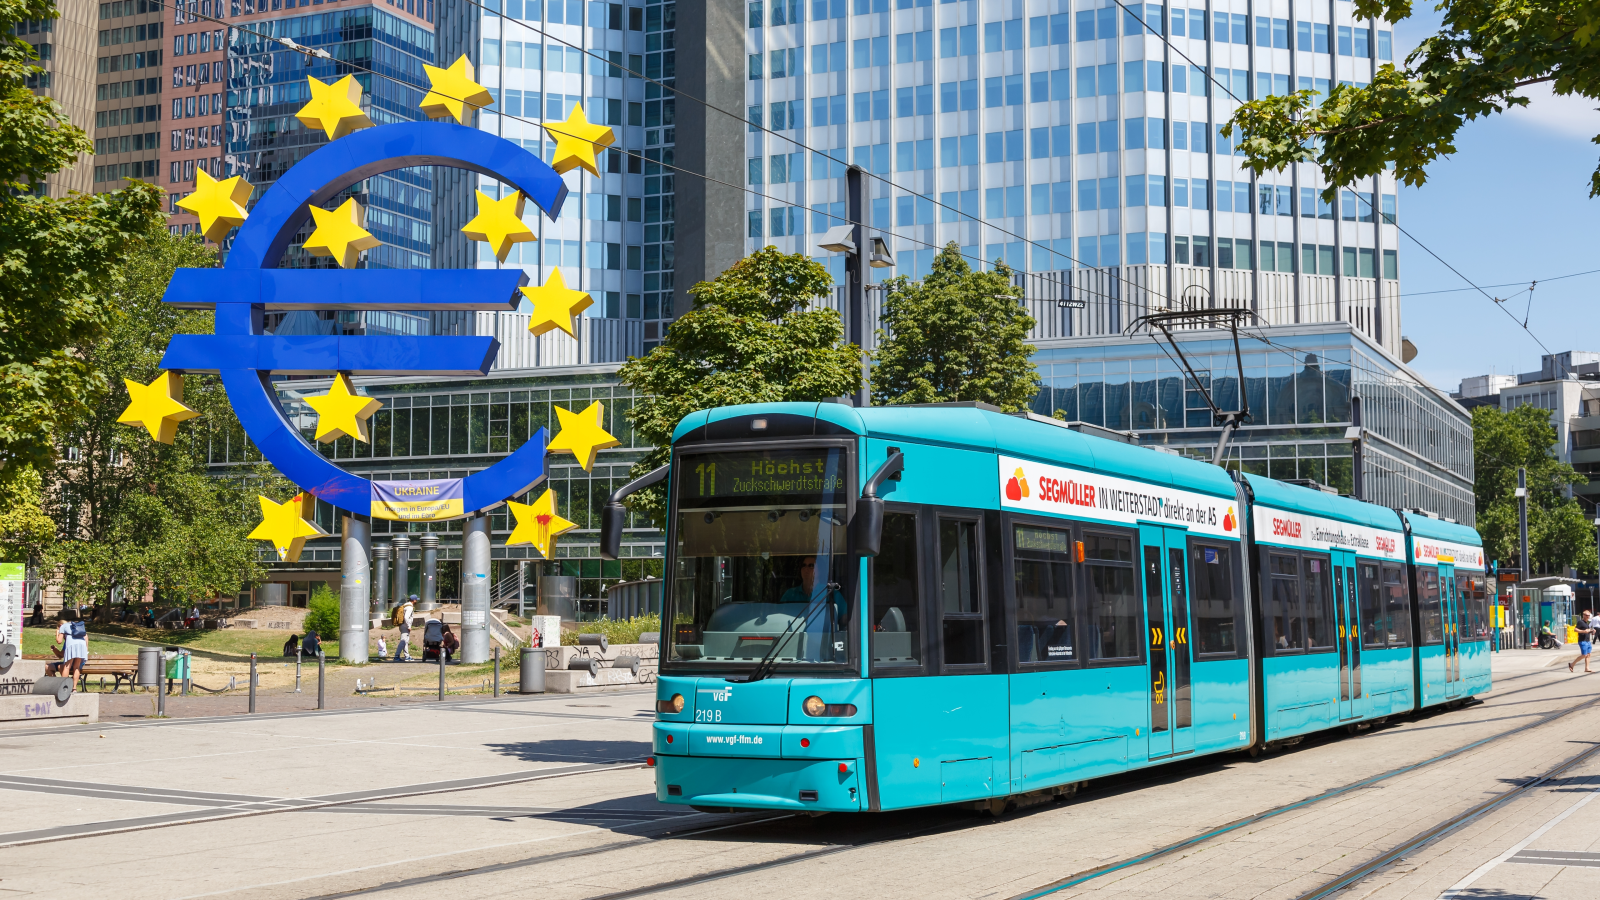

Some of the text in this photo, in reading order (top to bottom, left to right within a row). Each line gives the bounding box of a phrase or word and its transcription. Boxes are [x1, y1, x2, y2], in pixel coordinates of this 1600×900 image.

[751, 458, 824, 476] Höchst
[695, 462, 716, 496] 11
[394, 486, 440, 496] UKRAINE
[1039, 476, 1217, 526] SEGMÜLLER IN WEITERSTADT direkt an der A5
[1272, 517, 1302, 539] SEGMÜLLER
[713, 686, 733, 702] VGF
[695, 709, 722, 722] 219 B
[706, 734, 763, 746] www.vgf-ffm.de
